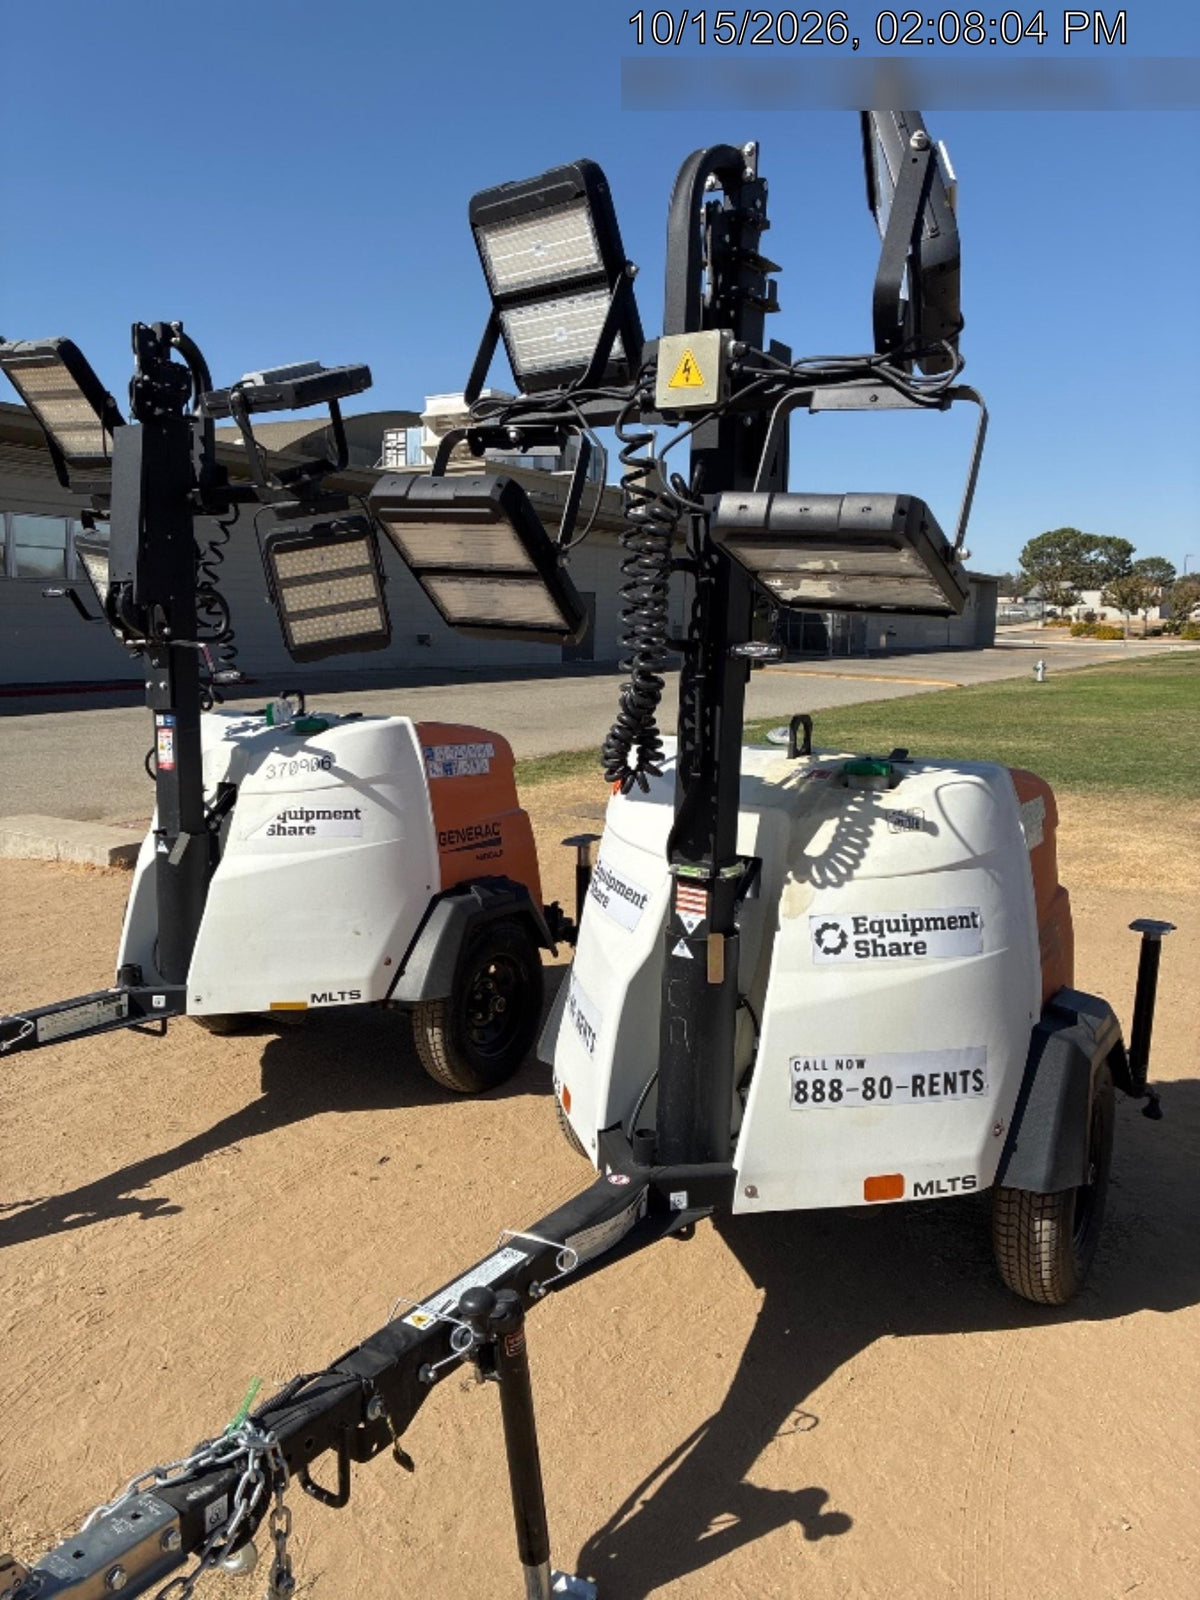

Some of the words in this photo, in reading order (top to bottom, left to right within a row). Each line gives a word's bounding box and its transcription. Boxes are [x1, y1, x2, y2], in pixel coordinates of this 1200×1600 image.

[438, 822, 501, 846] GENERAC
[852, 912, 979, 938] Equipment
[854, 939, 927, 958] Share
[310, 990, 361, 1003] MLTS
[794, 1060, 828, 1072] CALL
[835, 1058, 866, 1070] NOW
[794, 1068, 984, 1104] 888-80-RENTS
[913, 1174, 977, 1197] MLTS
